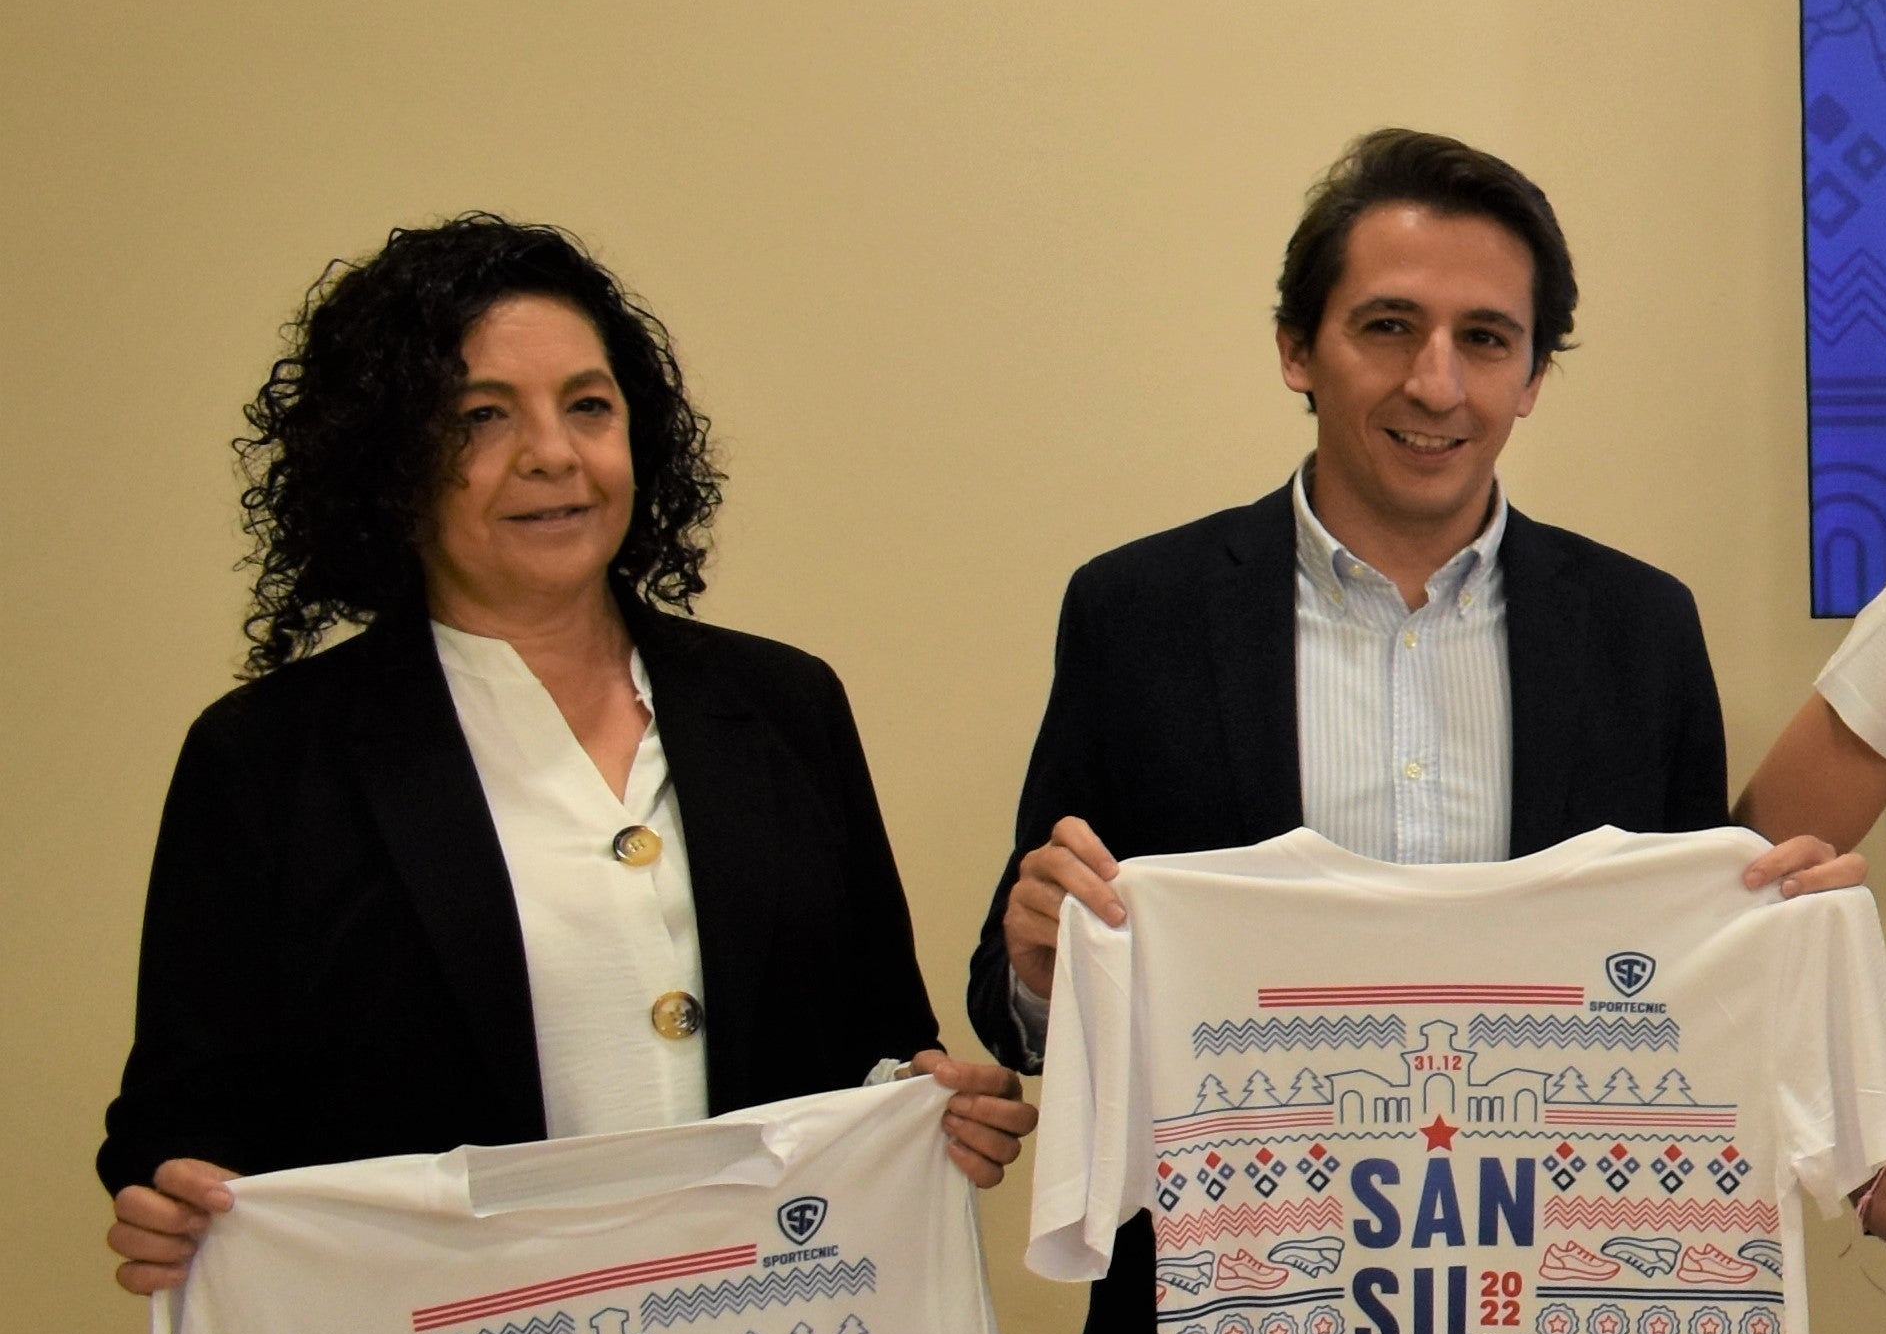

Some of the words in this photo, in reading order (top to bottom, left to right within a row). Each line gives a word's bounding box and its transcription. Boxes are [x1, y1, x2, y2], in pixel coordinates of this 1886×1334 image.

[1589, 1000, 1667, 1014] SPORTECNIC
[1414, 1055, 1462, 1071] 31.12
[1351, 1156, 1535, 1249] SAN
[763, 1245, 838, 1268] SPORTECNIC
[1481, 1270, 1522, 1297] 20
[1480, 1300, 1521, 1327] 22
